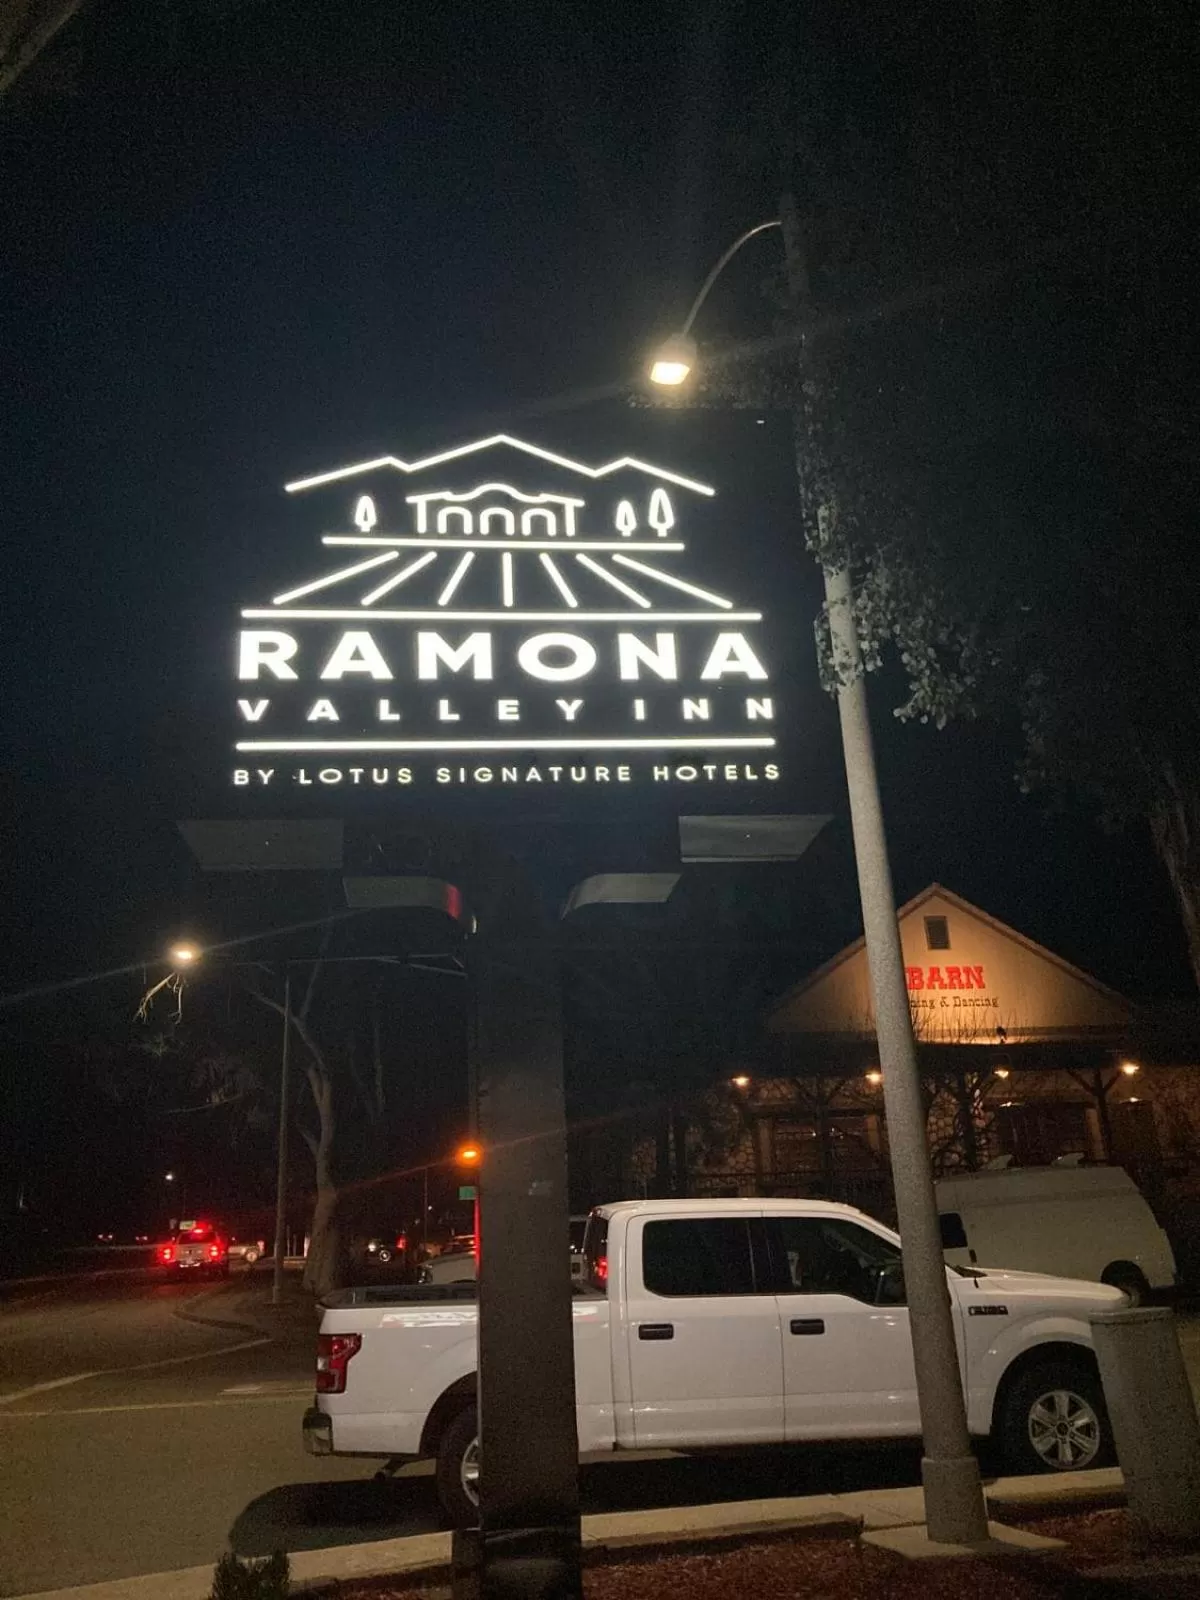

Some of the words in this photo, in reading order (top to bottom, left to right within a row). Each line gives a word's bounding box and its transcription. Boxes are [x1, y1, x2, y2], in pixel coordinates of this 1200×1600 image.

[236, 629, 769, 684] RAMONA
[237, 698, 584, 722] VALLEY
[633, 697, 774, 721] INN
[233, 768, 275, 786] BY
[299, 767, 413, 785] LOTUS
[436, 765, 631, 784] SIGNATURE
[653, 763, 780, 782] HOTELS
[905, 966, 986, 990] BARN
[910, 998, 936, 1010] ning
[952, 996, 999, 1008] Dancing
